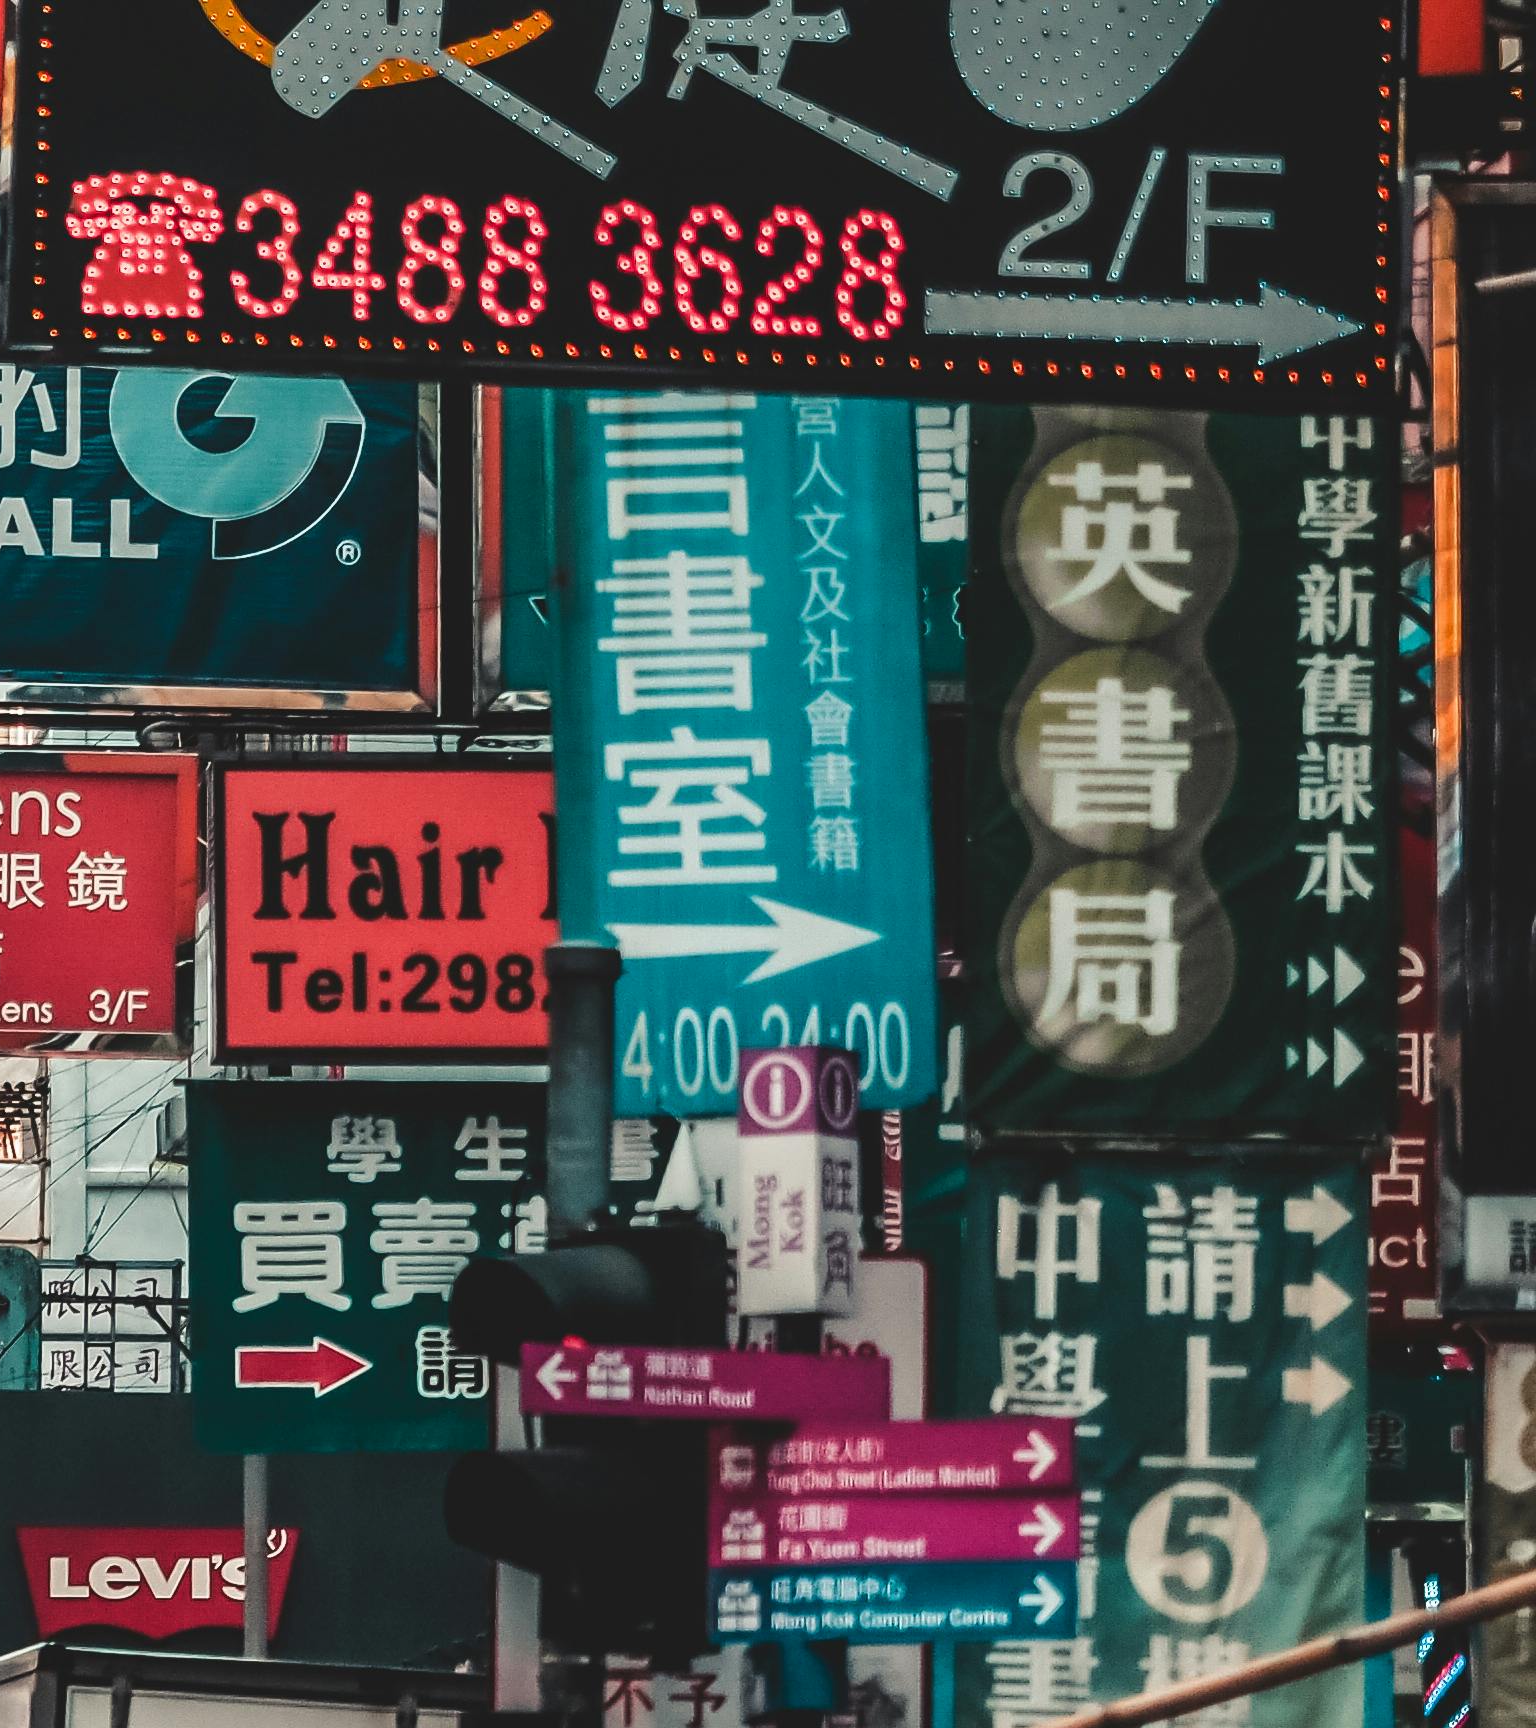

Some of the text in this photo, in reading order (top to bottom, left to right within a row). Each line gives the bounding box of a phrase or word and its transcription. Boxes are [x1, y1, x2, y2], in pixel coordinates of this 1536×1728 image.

[997, 147, 1286, 284] 2/F
[231, 190, 906, 341] 3488 3628
[1039, 461, 1195, 1038] 英書局
[253, 810, 504, 922] Hair
[87, 989, 149, 1026] 3/F
[251, 950, 552, 1015] Tel:298
[746, 1174, 777, 1270] Mong
[780, 1188, 805, 1254] Kok
[643, 1385, 757, 1410] Nathan Road
[863, 1537, 927, 1560] Street
